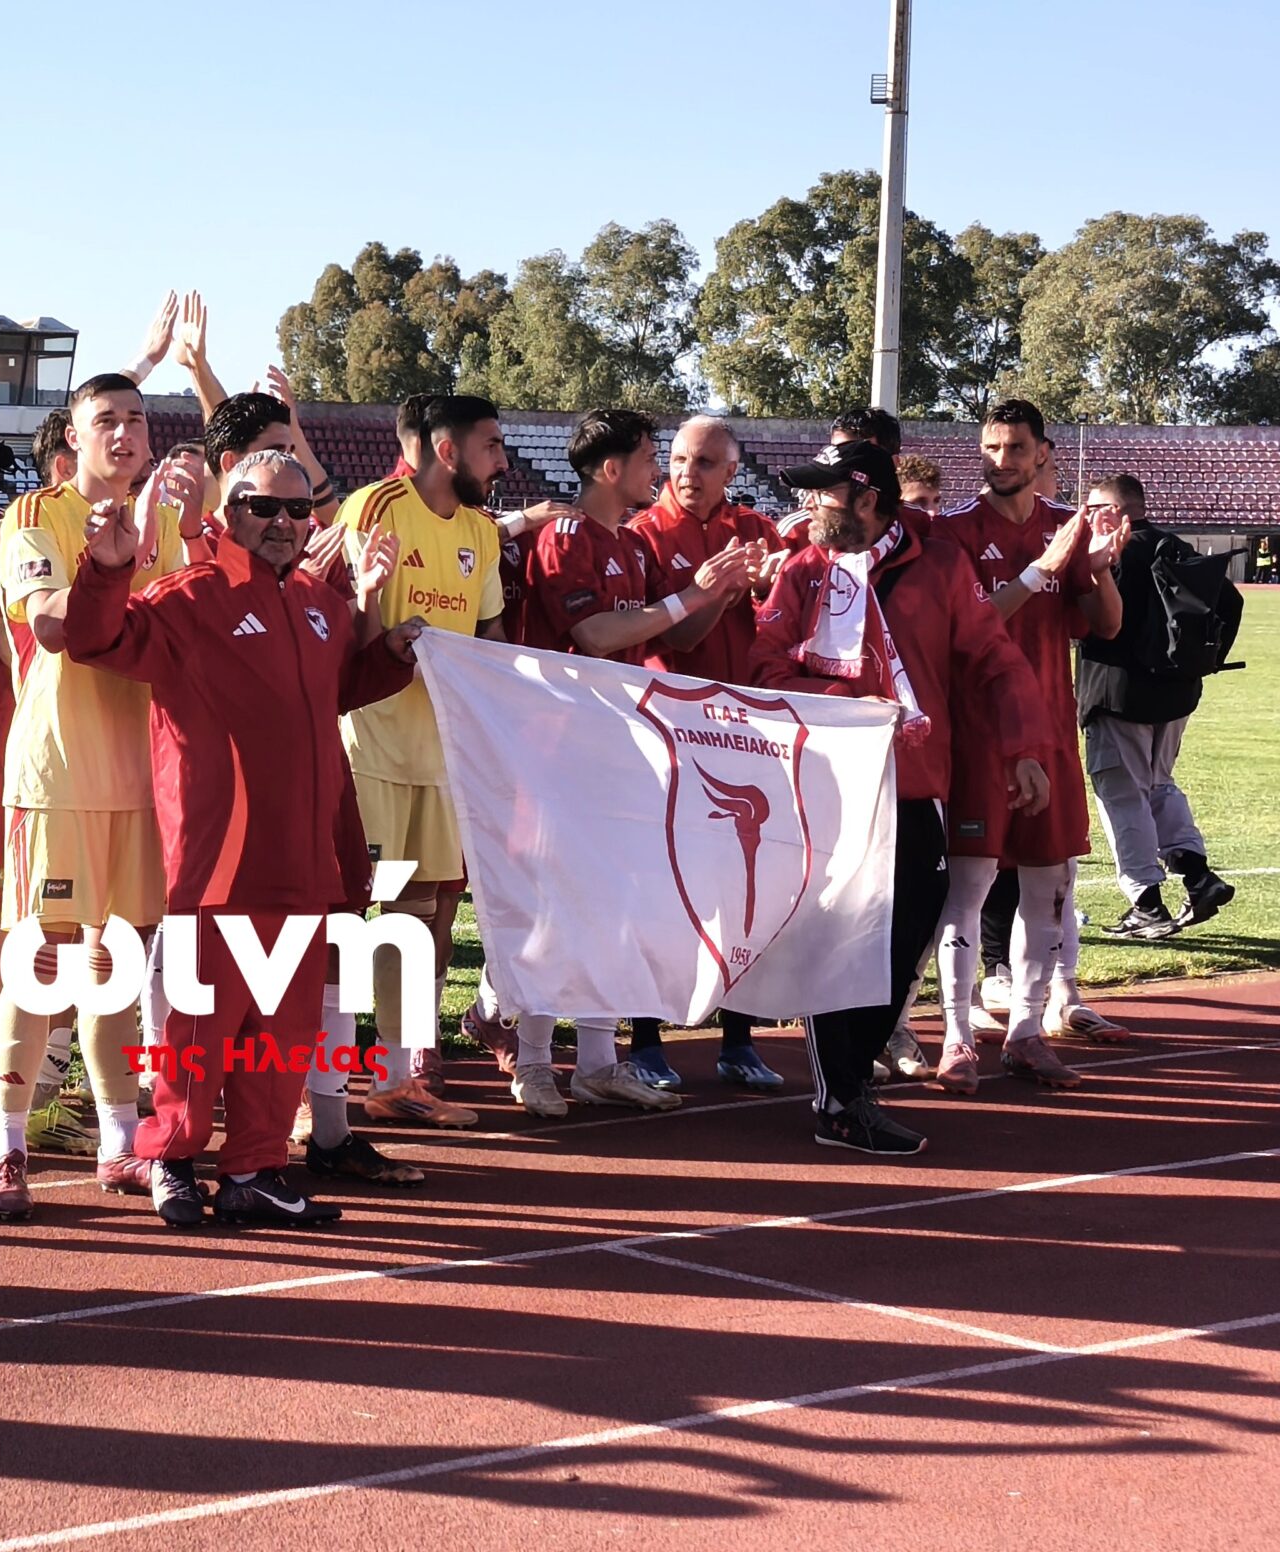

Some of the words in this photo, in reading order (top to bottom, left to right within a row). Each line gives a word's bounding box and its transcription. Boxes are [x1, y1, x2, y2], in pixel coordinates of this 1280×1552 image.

[408, 584, 467, 613] logitech
[673, 727, 791, 760] ΠΑΝΗΛΕΙΑΚΟΣ
[729, 946, 752, 967] 1958
